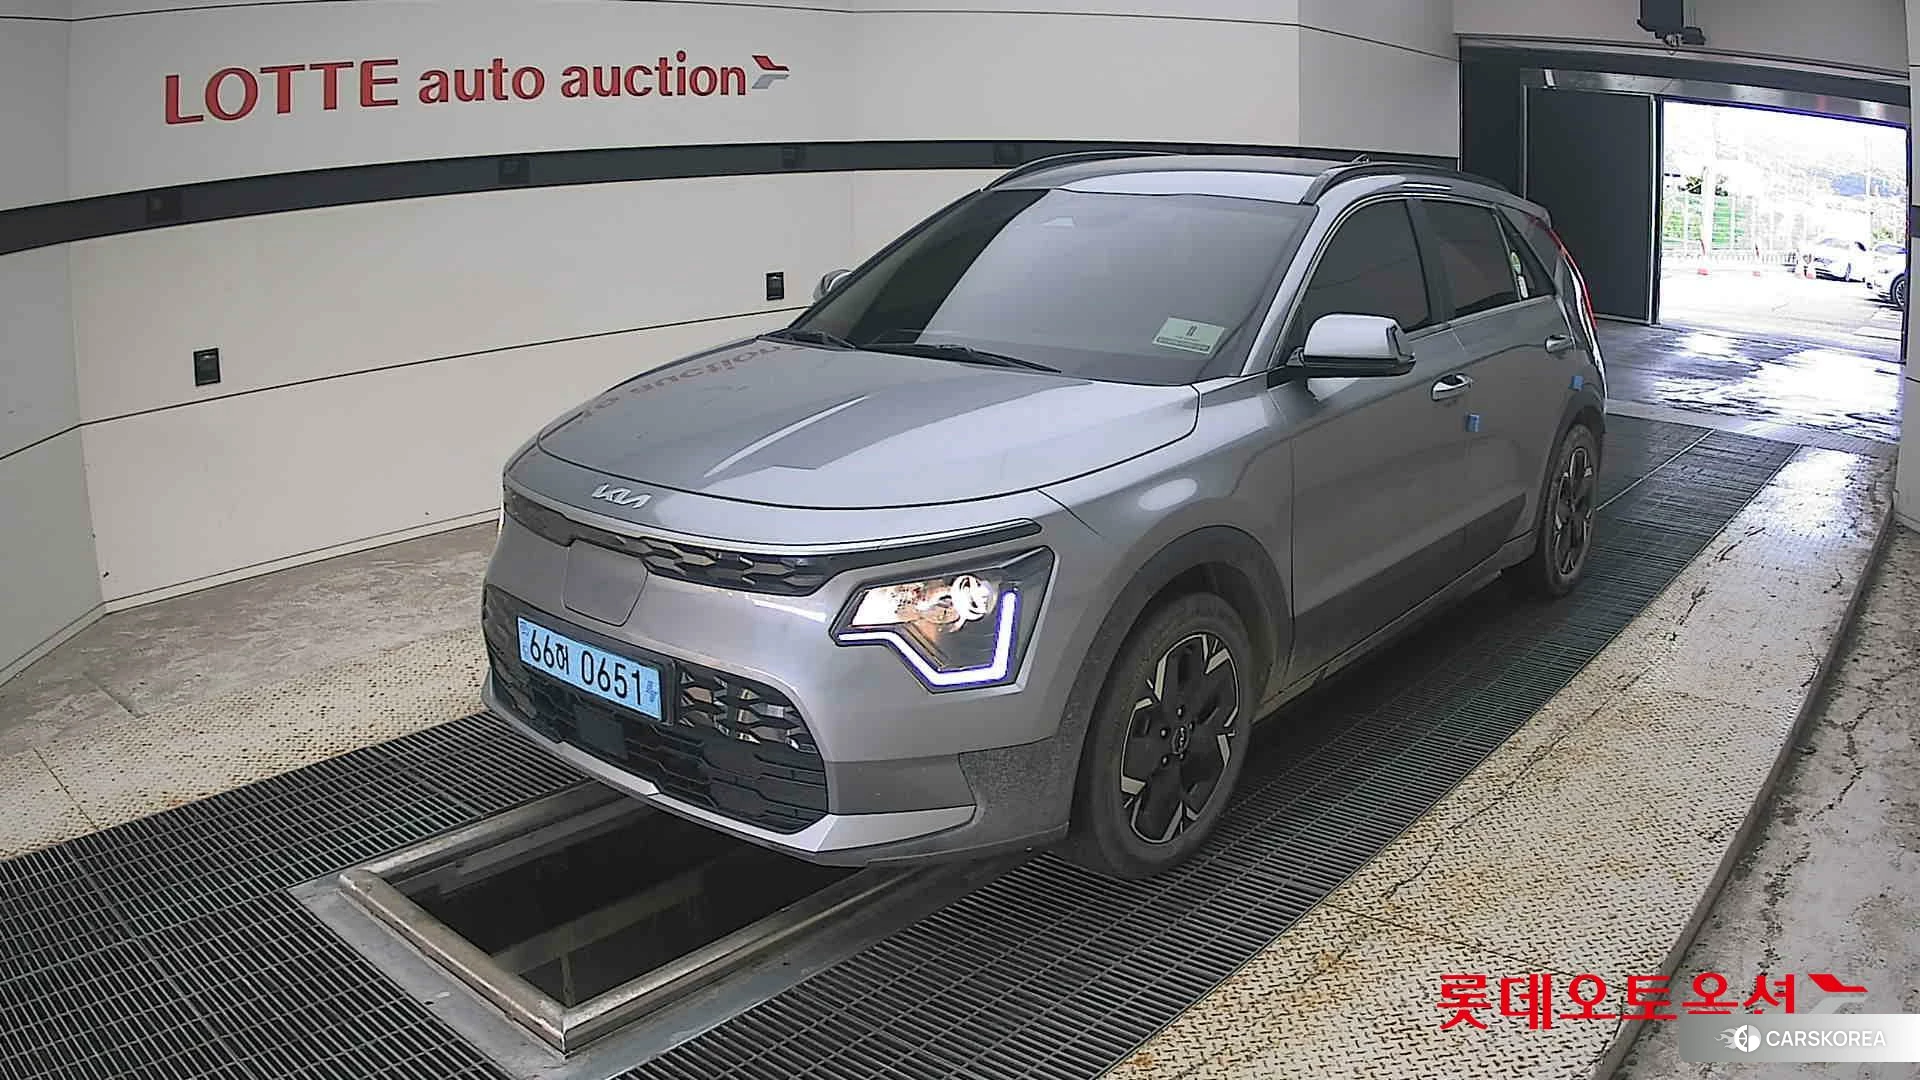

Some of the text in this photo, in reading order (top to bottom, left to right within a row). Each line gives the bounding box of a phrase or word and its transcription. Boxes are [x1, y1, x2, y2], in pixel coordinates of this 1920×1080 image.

[165, 50, 747, 125] LOTTE auto auction
[591, 483, 652, 509] KIA
[529, 629, 570, 675] 66허
[581, 650, 642, 706] 0651
